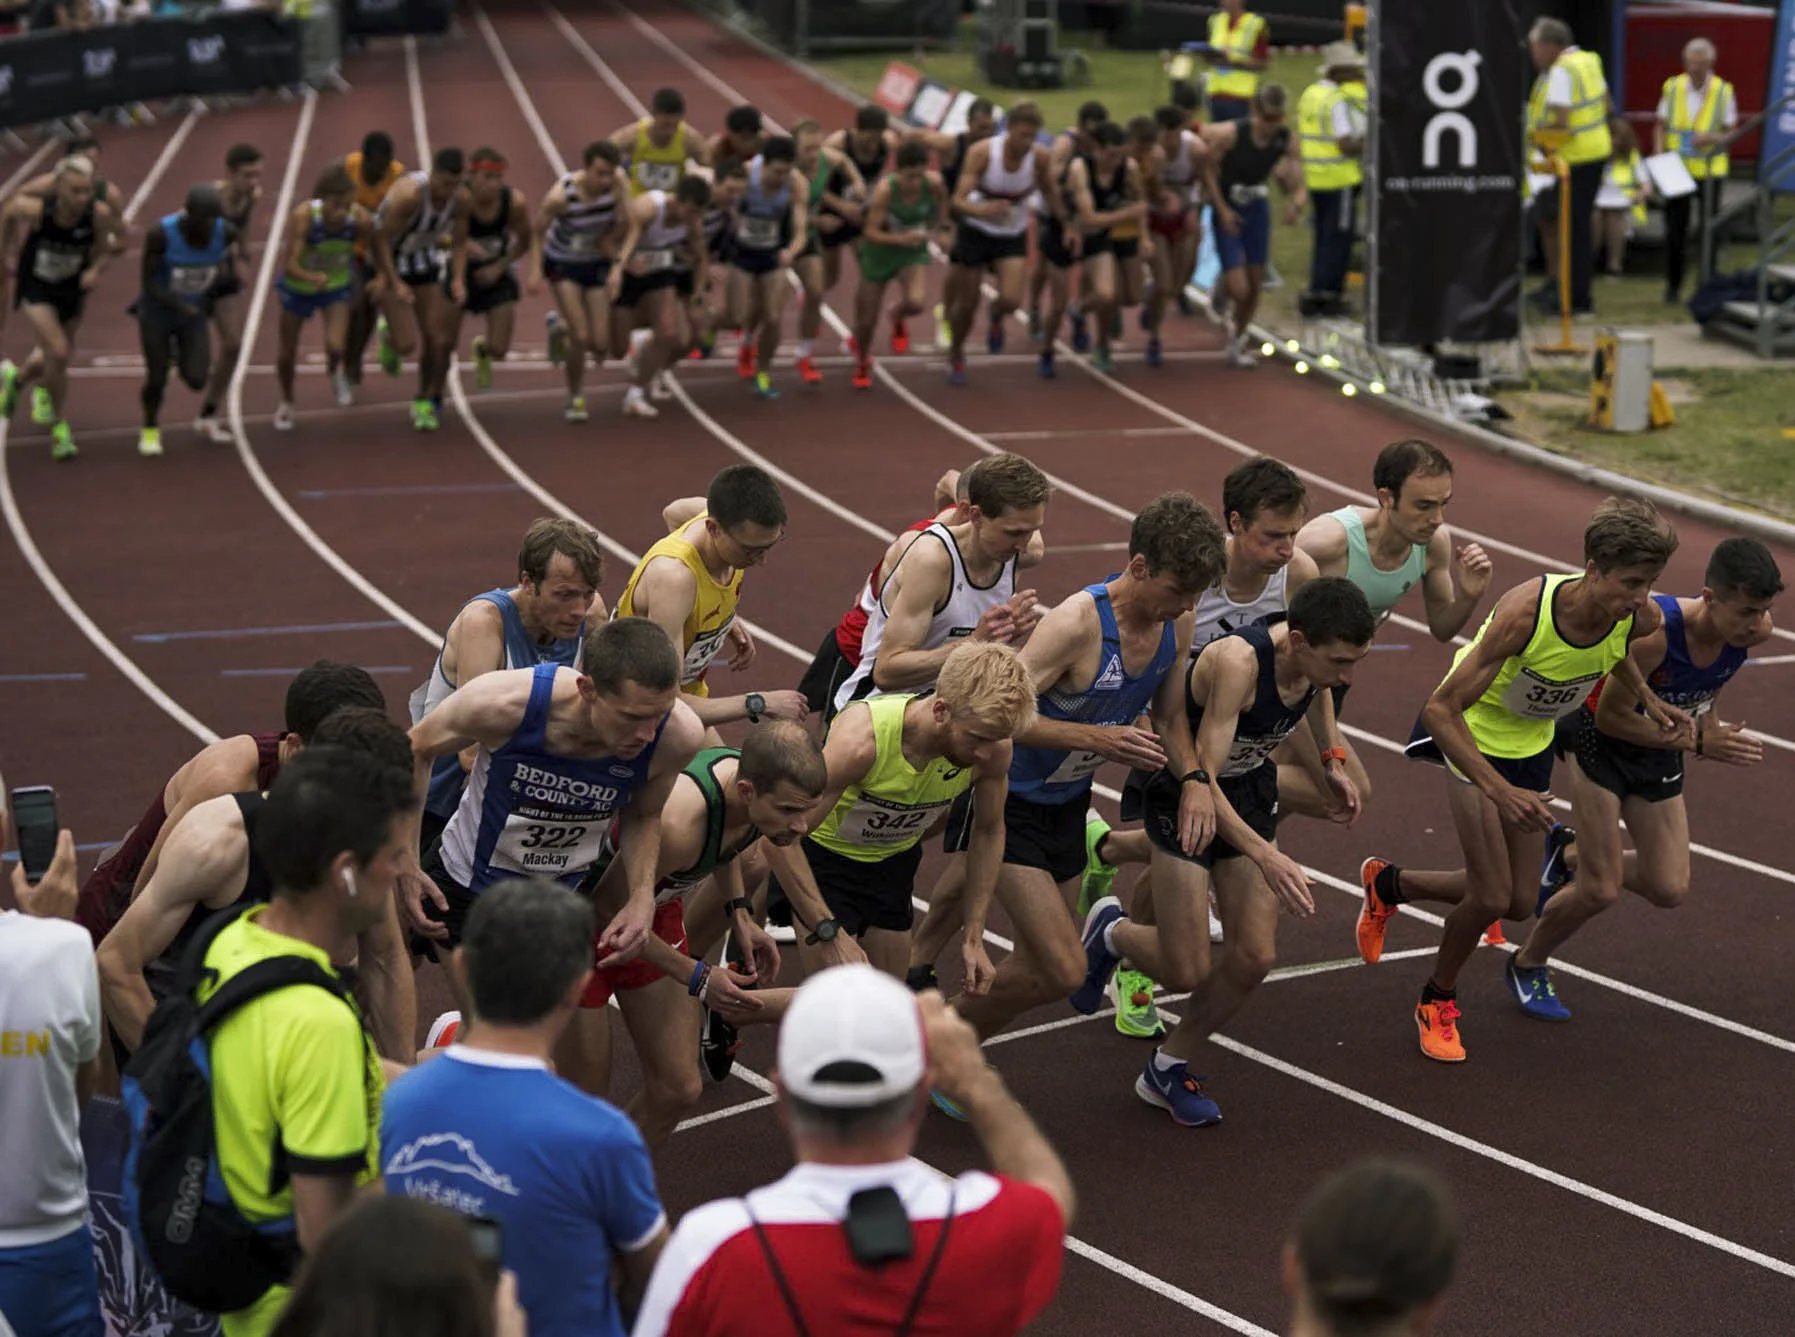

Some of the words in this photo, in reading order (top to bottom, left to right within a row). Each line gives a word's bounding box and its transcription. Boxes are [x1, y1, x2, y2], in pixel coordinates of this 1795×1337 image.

[1526, 685, 1580, 704] 336
[514, 762, 618, 802] BEDFORD
[510, 780, 521, 793] &
[592, 800, 613, 812] AC
[867, 811, 927, 830] 342
[521, 824, 587, 849] 322
[522, 852, 569, 868] Mackay
[2, 1030, 50, 1057] EN
